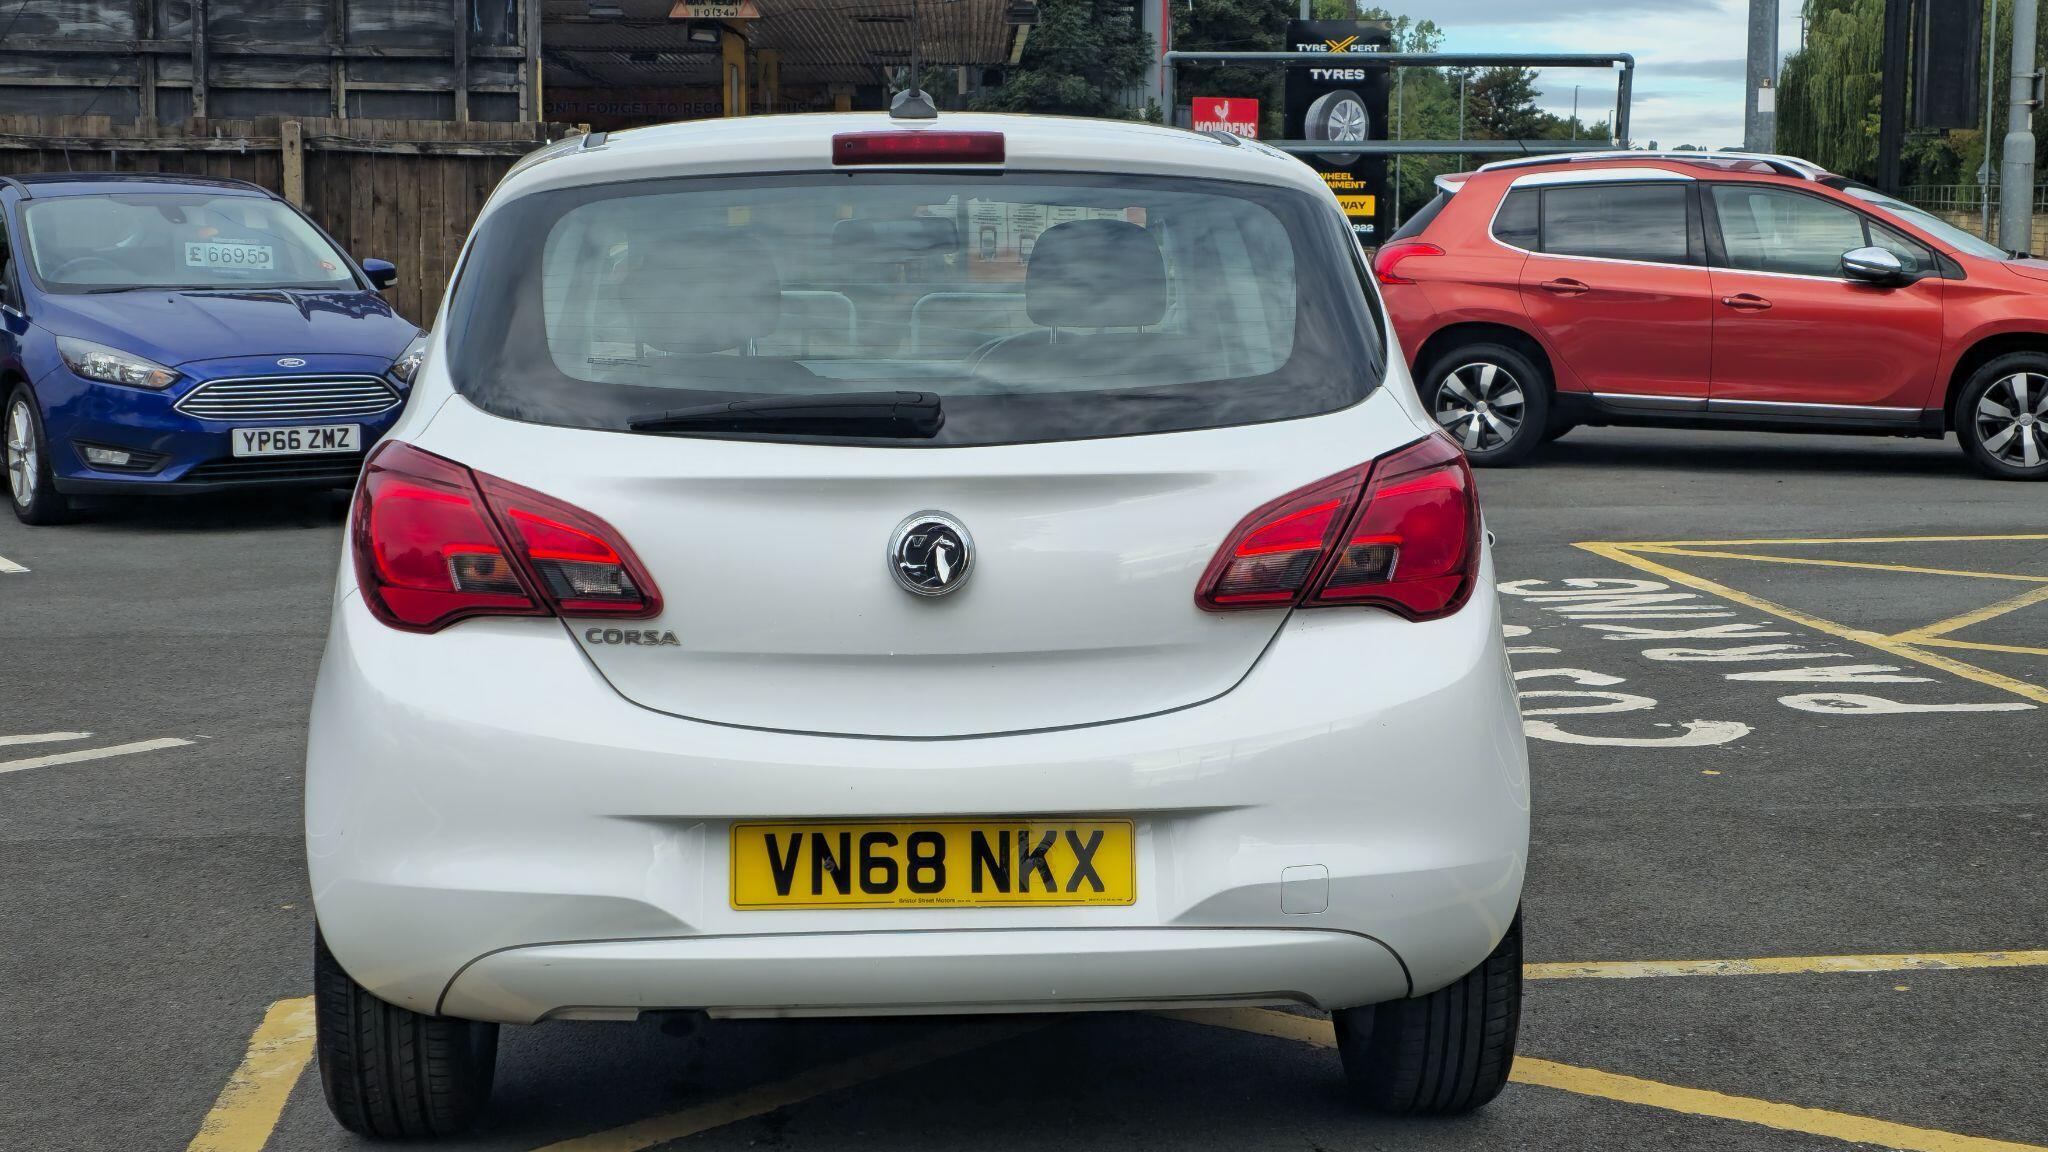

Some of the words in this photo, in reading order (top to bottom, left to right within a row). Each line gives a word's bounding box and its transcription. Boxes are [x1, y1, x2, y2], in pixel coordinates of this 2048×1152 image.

[1309, 68, 1366, 81] TYRES
[586, 102, 651, 114] FORGET
[660, 102, 680, 114] TO
[1328, 181, 1367, 189] NMENT
[243, 430, 301, 452] YP66
[308, 427, 350, 449] ZMZ
[585, 627, 682, 647] CORSA
[764, 830, 947, 896] VN68
[970, 829, 1105, 894] NKX
[935, 896, 956, 904] Motors
